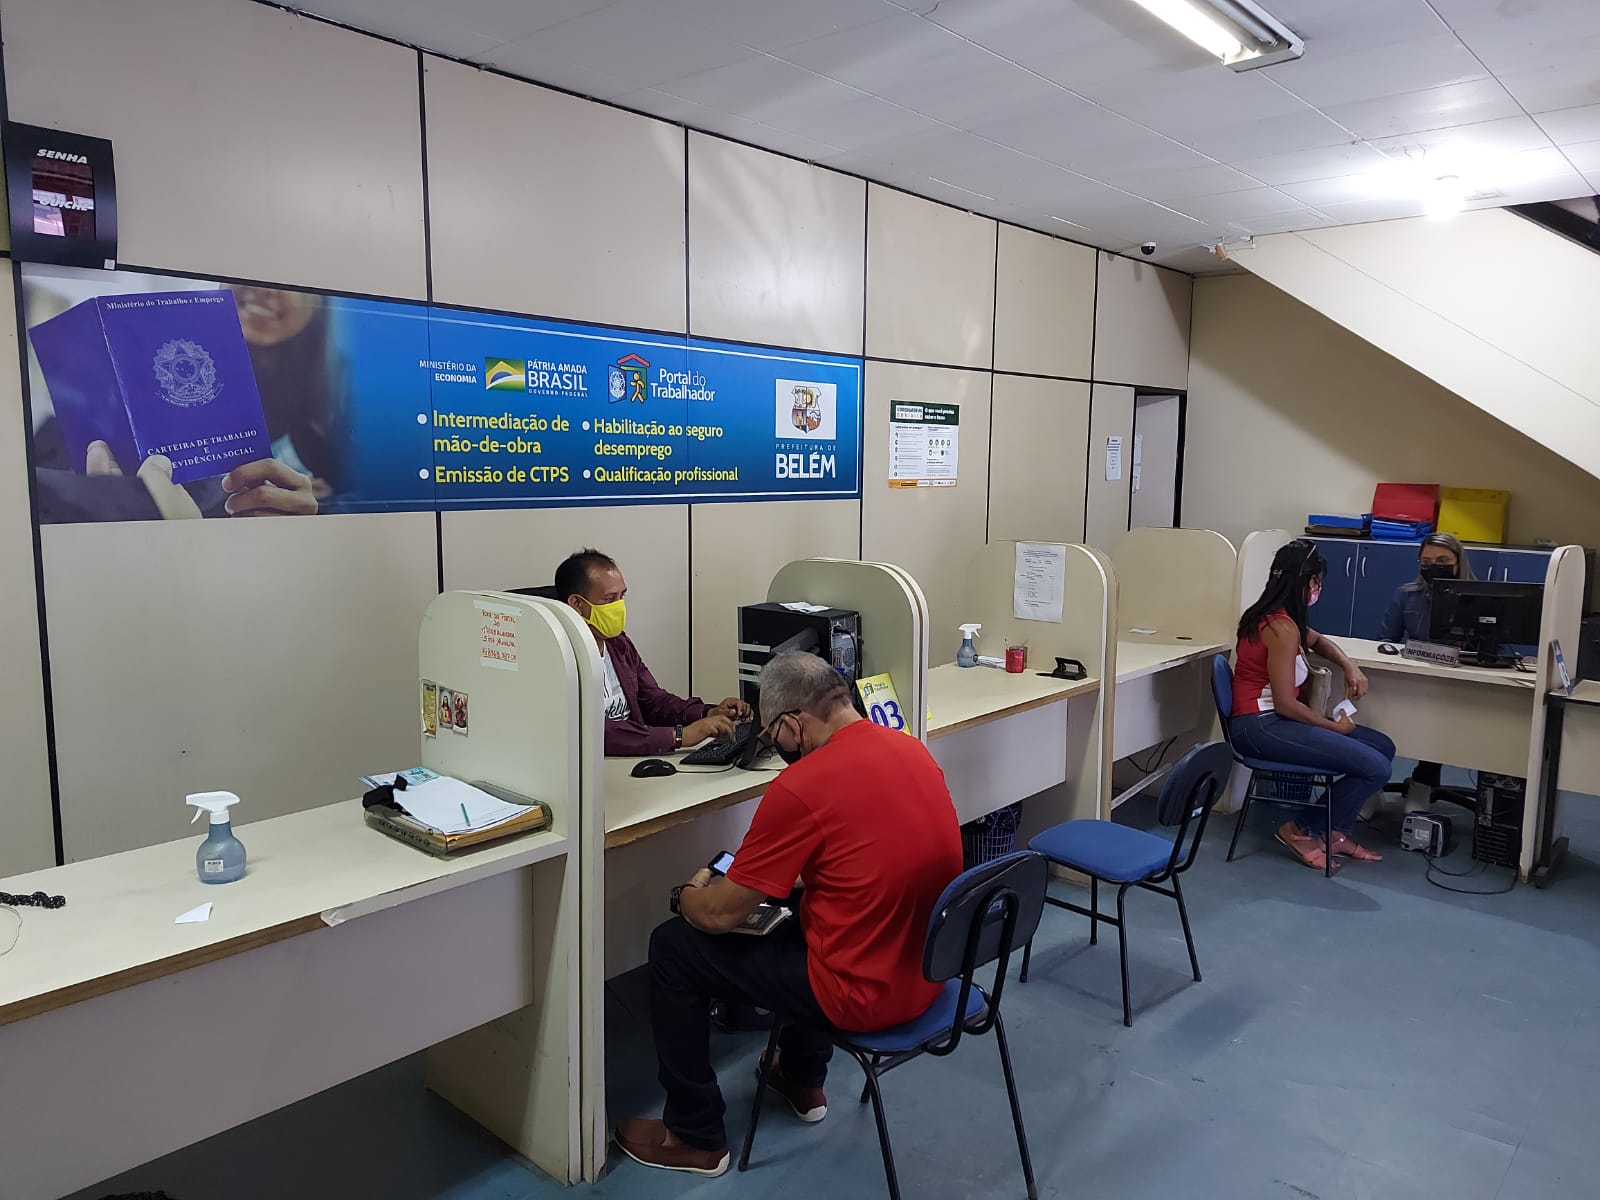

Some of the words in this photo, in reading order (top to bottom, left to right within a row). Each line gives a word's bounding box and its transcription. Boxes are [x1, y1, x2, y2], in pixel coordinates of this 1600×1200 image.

[36, 149, 88, 164] SENHA
[106, 300, 145, 310] Ministério
[156, 297, 188, 306] Trabalho
[194, 296, 224, 304] Emprego
[419, 359, 465, 371] MINISTÉRIO
[466, 363, 477, 373] DA
[527, 358, 557, 371] PÁTRIA
[557, 363, 588, 375] AMADA
[435, 374, 477, 384] ECONOMIA
[528, 370, 588, 391] BRASIL
[659, 368, 691, 385] Portal
[692, 371, 706, 387] do
[528, 388, 559, 396] GOVERNO
[561, 390, 588, 398] FEDERAL
[650, 382, 716, 402] Trabalhador
[433, 409, 548, 434] Intermediação
[551, 414, 570, 431] de
[594, 417, 666, 438] Habilitação
[668, 424, 683, 436] ao
[686, 424, 724, 441] seguro
[147, 440, 196, 456] CARTEIRA
[196, 438, 209, 446] DE
[210, 429, 257, 442] TRABALHO
[433, 434, 542, 454] mão-de-obra
[594, 439, 673, 461] desemprego
[775, 443, 824, 451] PREFEITURA
[171, 453, 222, 469] EVIDÊNCIA
[222, 446, 255, 458] SOCIAL
[775, 451, 836, 479] BELÉM
[435, 465, 503, 483] Emissão
[506, 465, 526, 483] de
[529, 466, 570, 483] CTPS
[594, 465, 672, 485] Qualificação
[674, 466, 739, 486] profissional
[870, 700, 904, 731] 03
